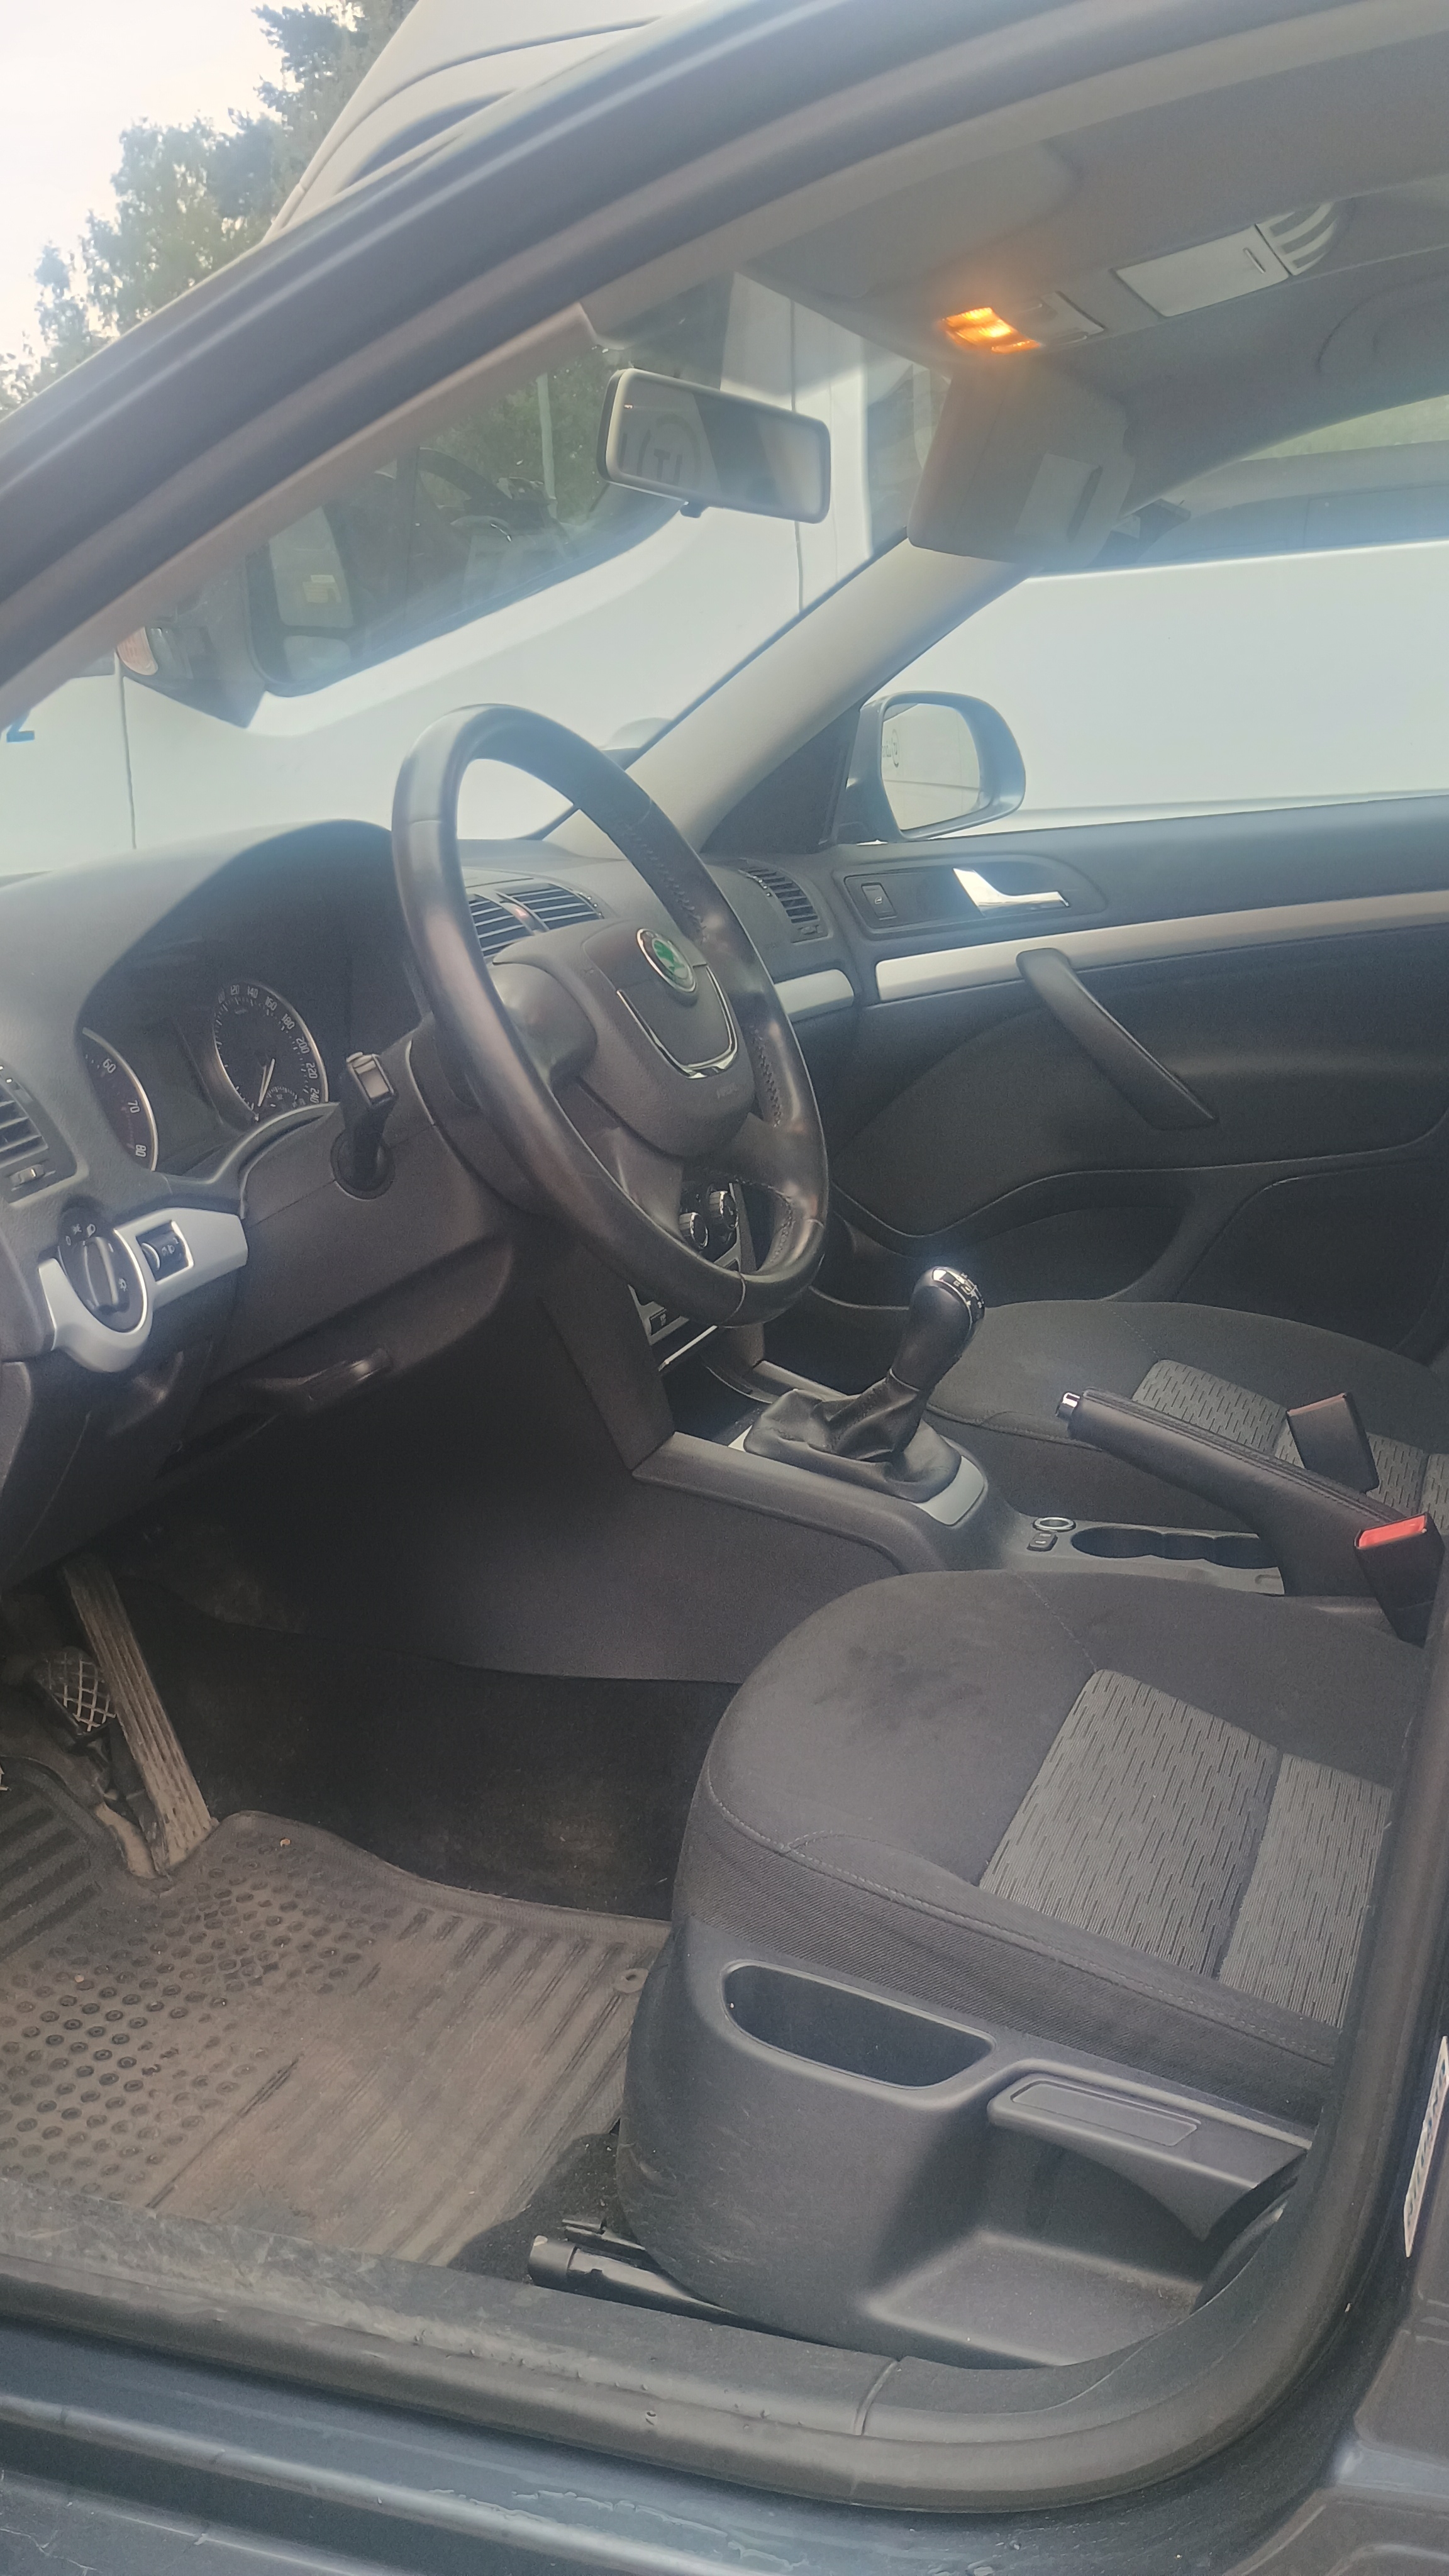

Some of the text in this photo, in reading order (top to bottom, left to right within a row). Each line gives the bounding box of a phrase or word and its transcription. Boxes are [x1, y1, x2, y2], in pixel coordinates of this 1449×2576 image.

[265, 996, 277, 1011] 160
[281, 1013, 295, 1030] 180
[296, 1036, 310, 1054] 200
[103, 1058, 116, 1074] 60
[306, 1063, 318, 1079] 220
[309, 1087, 319, 1104] 240
[128, 1100, 140, 1114] 70
[135, 1144, 147, 1158] 80
